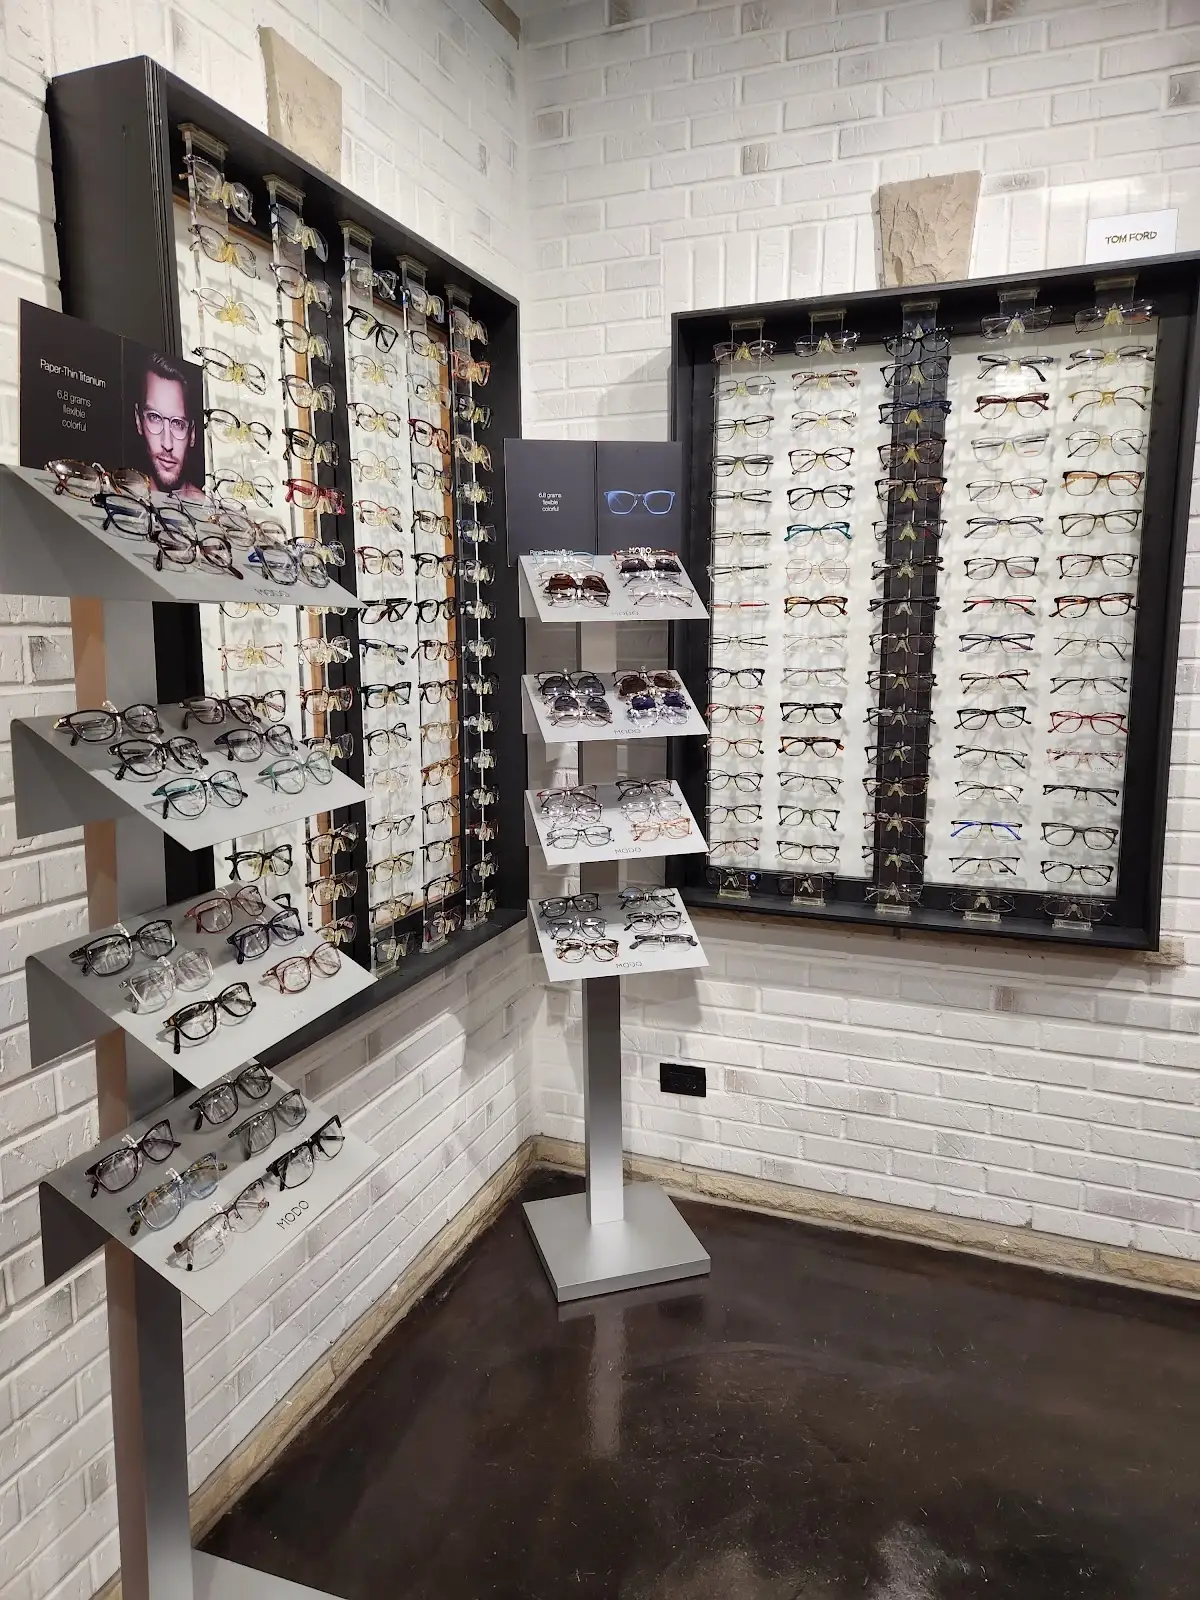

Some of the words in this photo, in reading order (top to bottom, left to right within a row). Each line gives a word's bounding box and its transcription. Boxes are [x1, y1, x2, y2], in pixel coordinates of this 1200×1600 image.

[1104, 233, 1128, 245] TOM
[1129, 230, 1158, 242] FORD
[40, 358, 79, 380] Paper-Thin
[78, 370, 106, 389] Titanium
[56, 389, 69, 401] 6.8
[69, 394, 92, 408] grams
[62, 403, 86, 419] flexible
[61, 419, 87, 432] colorful
[614, 846, 642, 854] MODO
[615, 961, 643, 969] MODO
[276, 1200, 309, 1230] MODO
